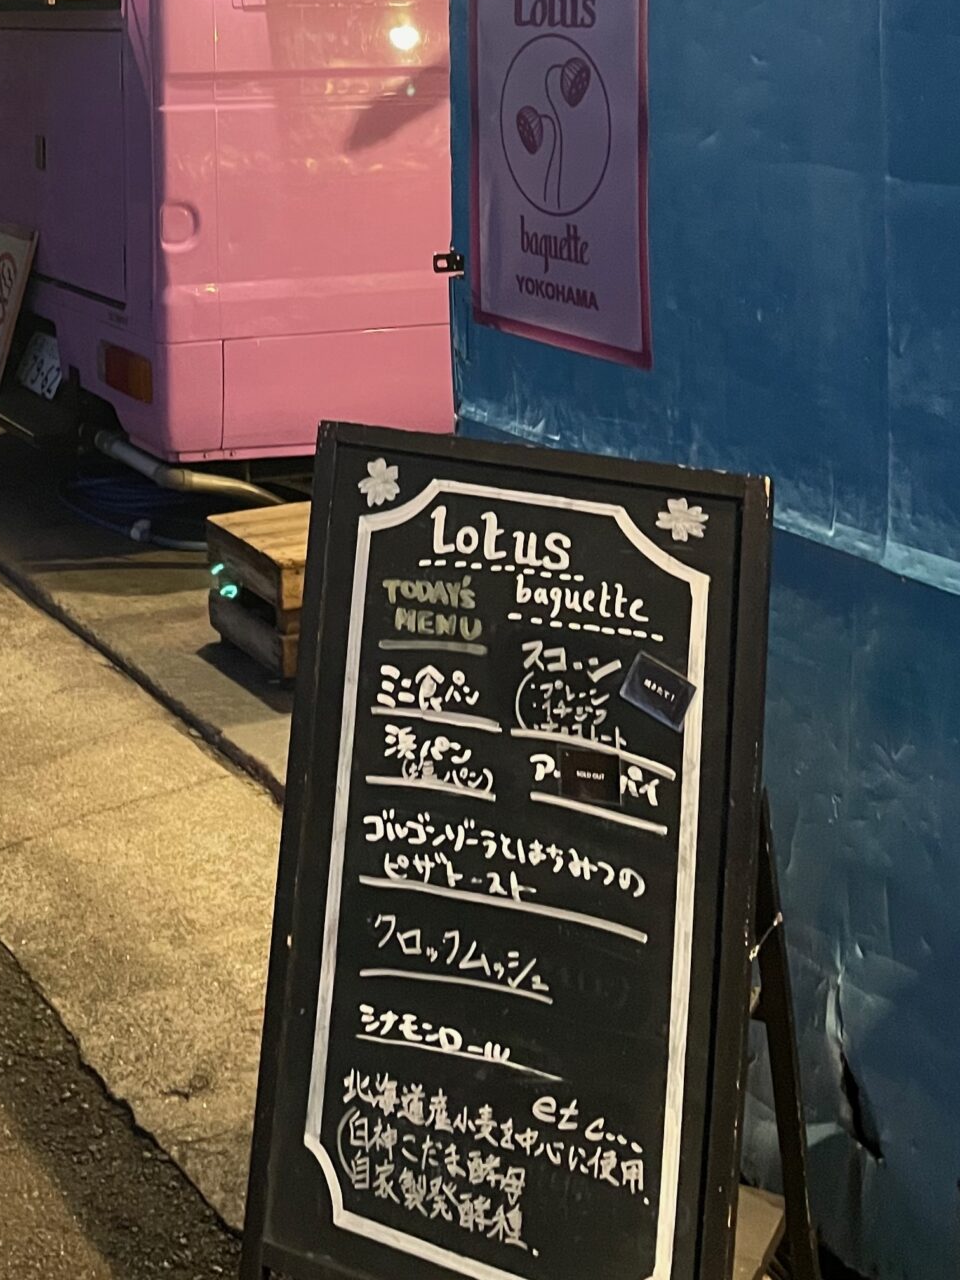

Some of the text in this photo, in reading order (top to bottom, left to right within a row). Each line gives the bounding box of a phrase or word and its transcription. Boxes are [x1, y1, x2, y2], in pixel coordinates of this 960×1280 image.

[520, 215, 591, 274] baguette
[516, 274, 599, 312] YOKOHAMA
[431, 505, 572, 570] Lotus
[516, 573, 650, 622] baguette
[395, 607, 483, 641] MENU
[521, 640, 622, 683] スコーン
[377, 664, 479, 712] ミニ食パン
[384, 723, 472, 770] 浜パン
[575, 769, 606, 781] SOLD OUT
[362, 808, 646, 898] ゴルゴンゾーラとはちみつの
[384, 852, 537, 903] ピザトースト
[374, 914, 550, 992] クロックムッシュ
[359, 1003, 511, 1063] シナモンロール
